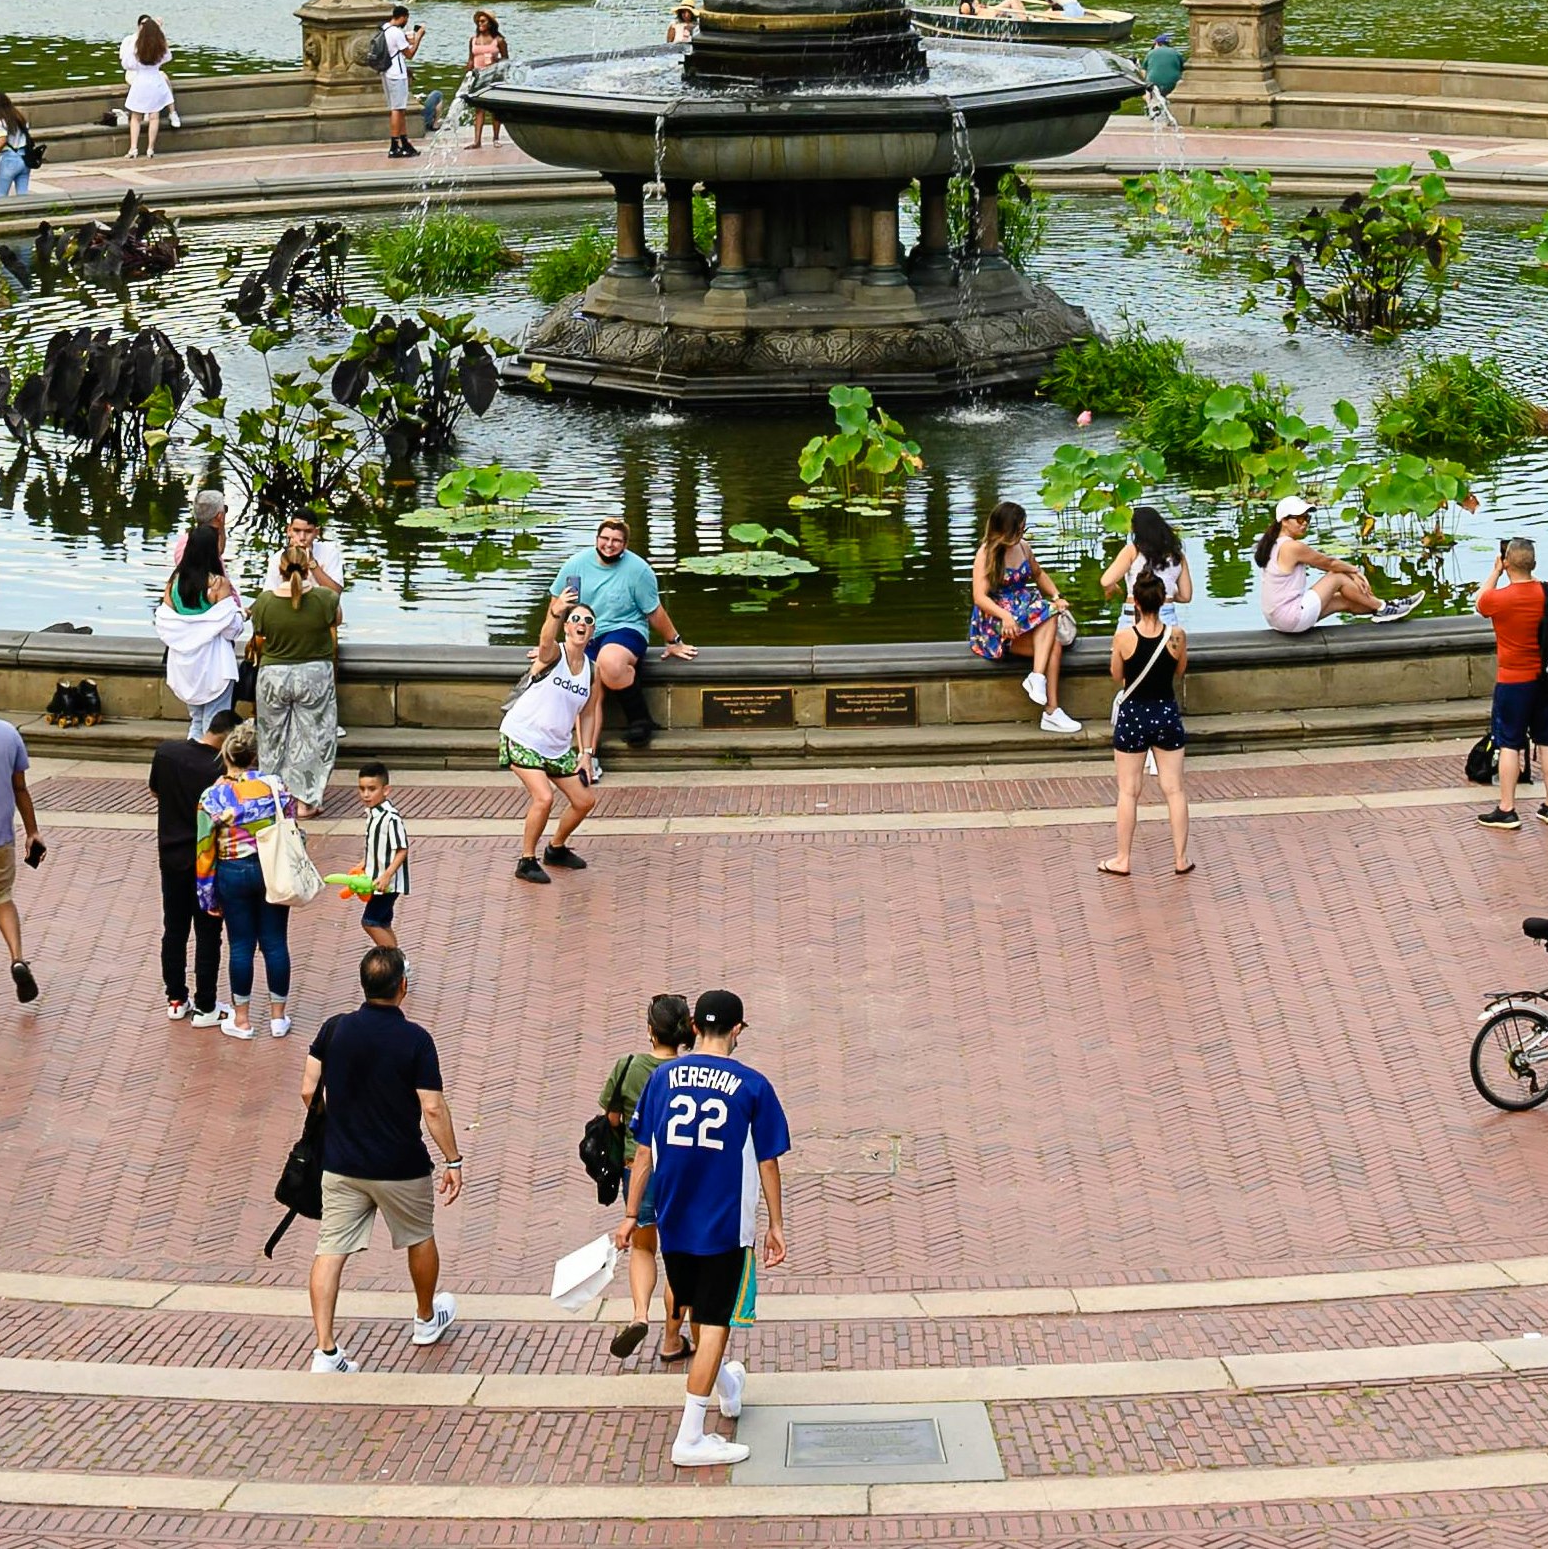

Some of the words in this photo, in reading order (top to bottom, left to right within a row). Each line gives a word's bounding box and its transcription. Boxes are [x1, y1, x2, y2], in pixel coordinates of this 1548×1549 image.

[553, 676, 589, 698] adidas
[669, 1066, 742, 1096] KERSHAW
[666, 1094, 728, 1151] 22
